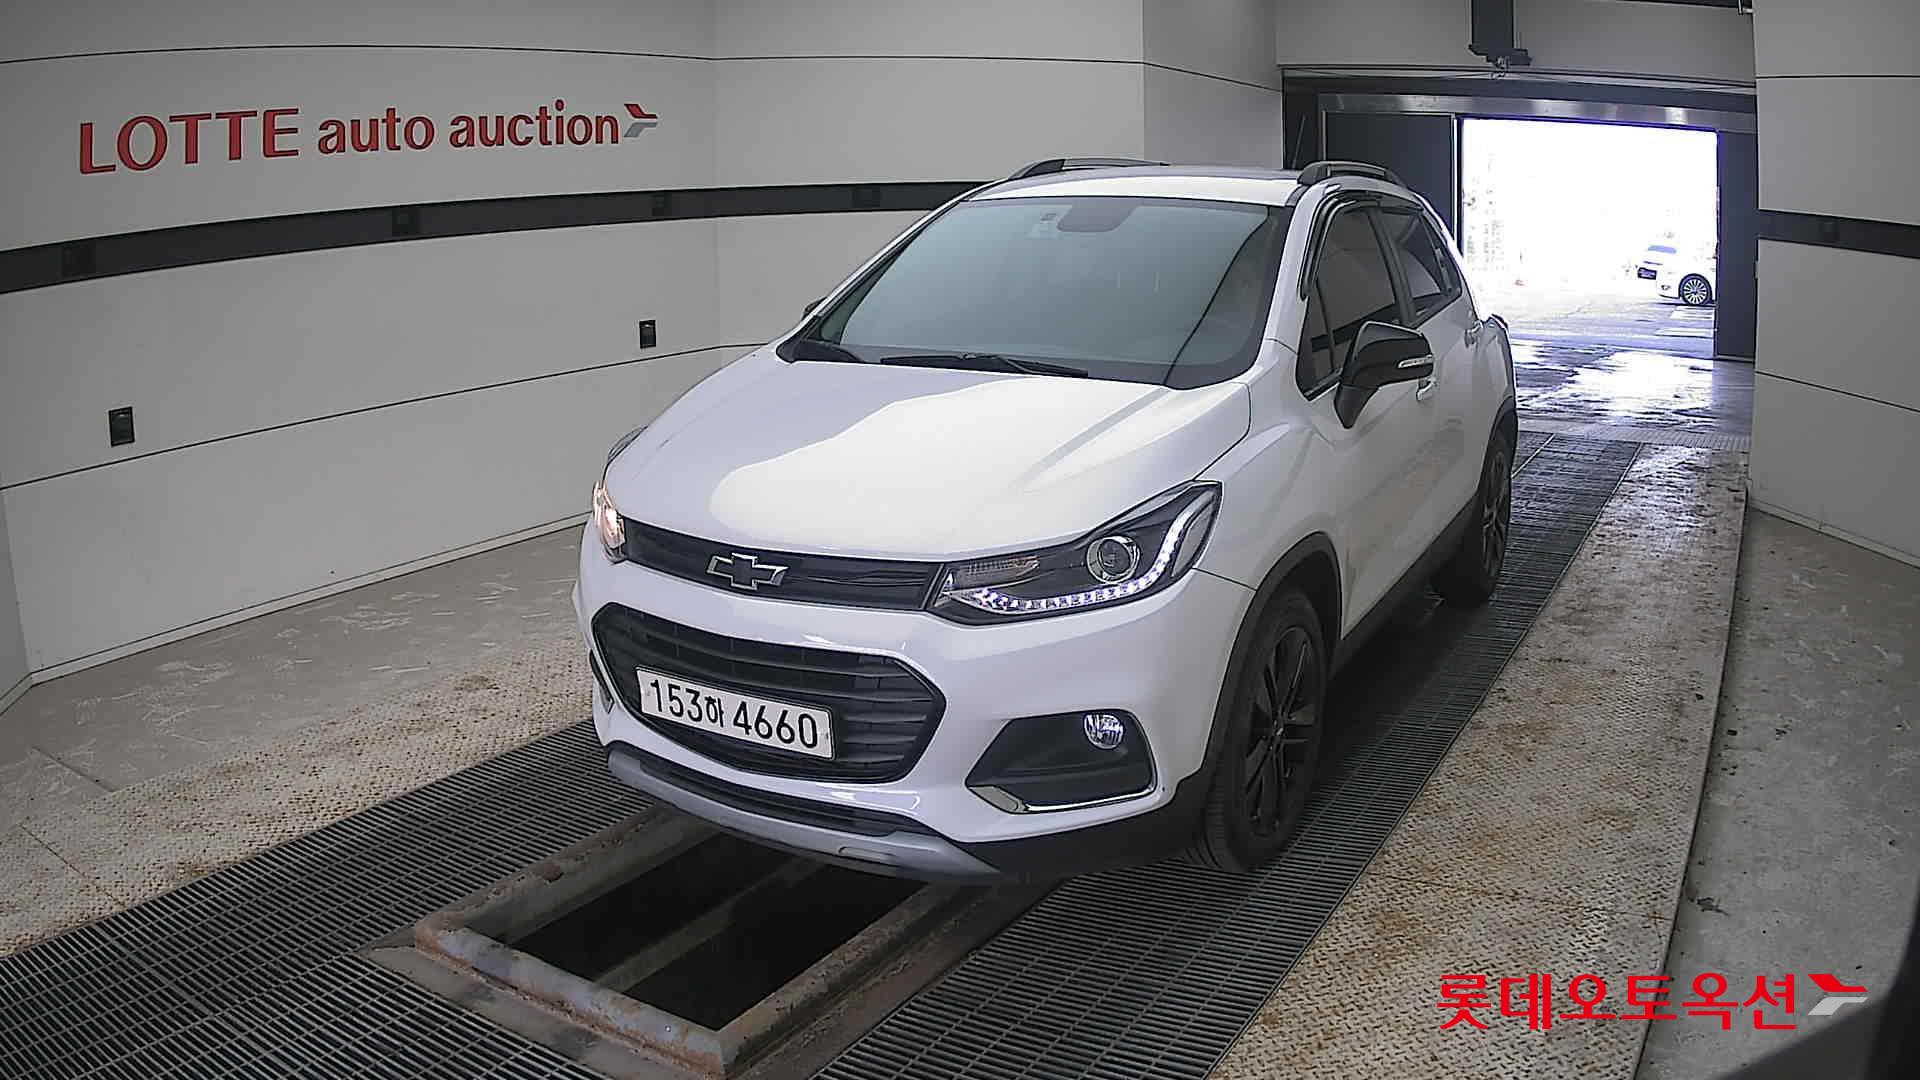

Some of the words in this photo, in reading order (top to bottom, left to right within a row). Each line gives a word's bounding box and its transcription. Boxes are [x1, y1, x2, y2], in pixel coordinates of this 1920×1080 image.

[79, 107, 300, 175] LOTTE
[317, 107, 435, 155] auto
[449, 99, 620, 149] auction
[650, 679, 725, 729] 153하
[733, 701, 818, 749] 4660
